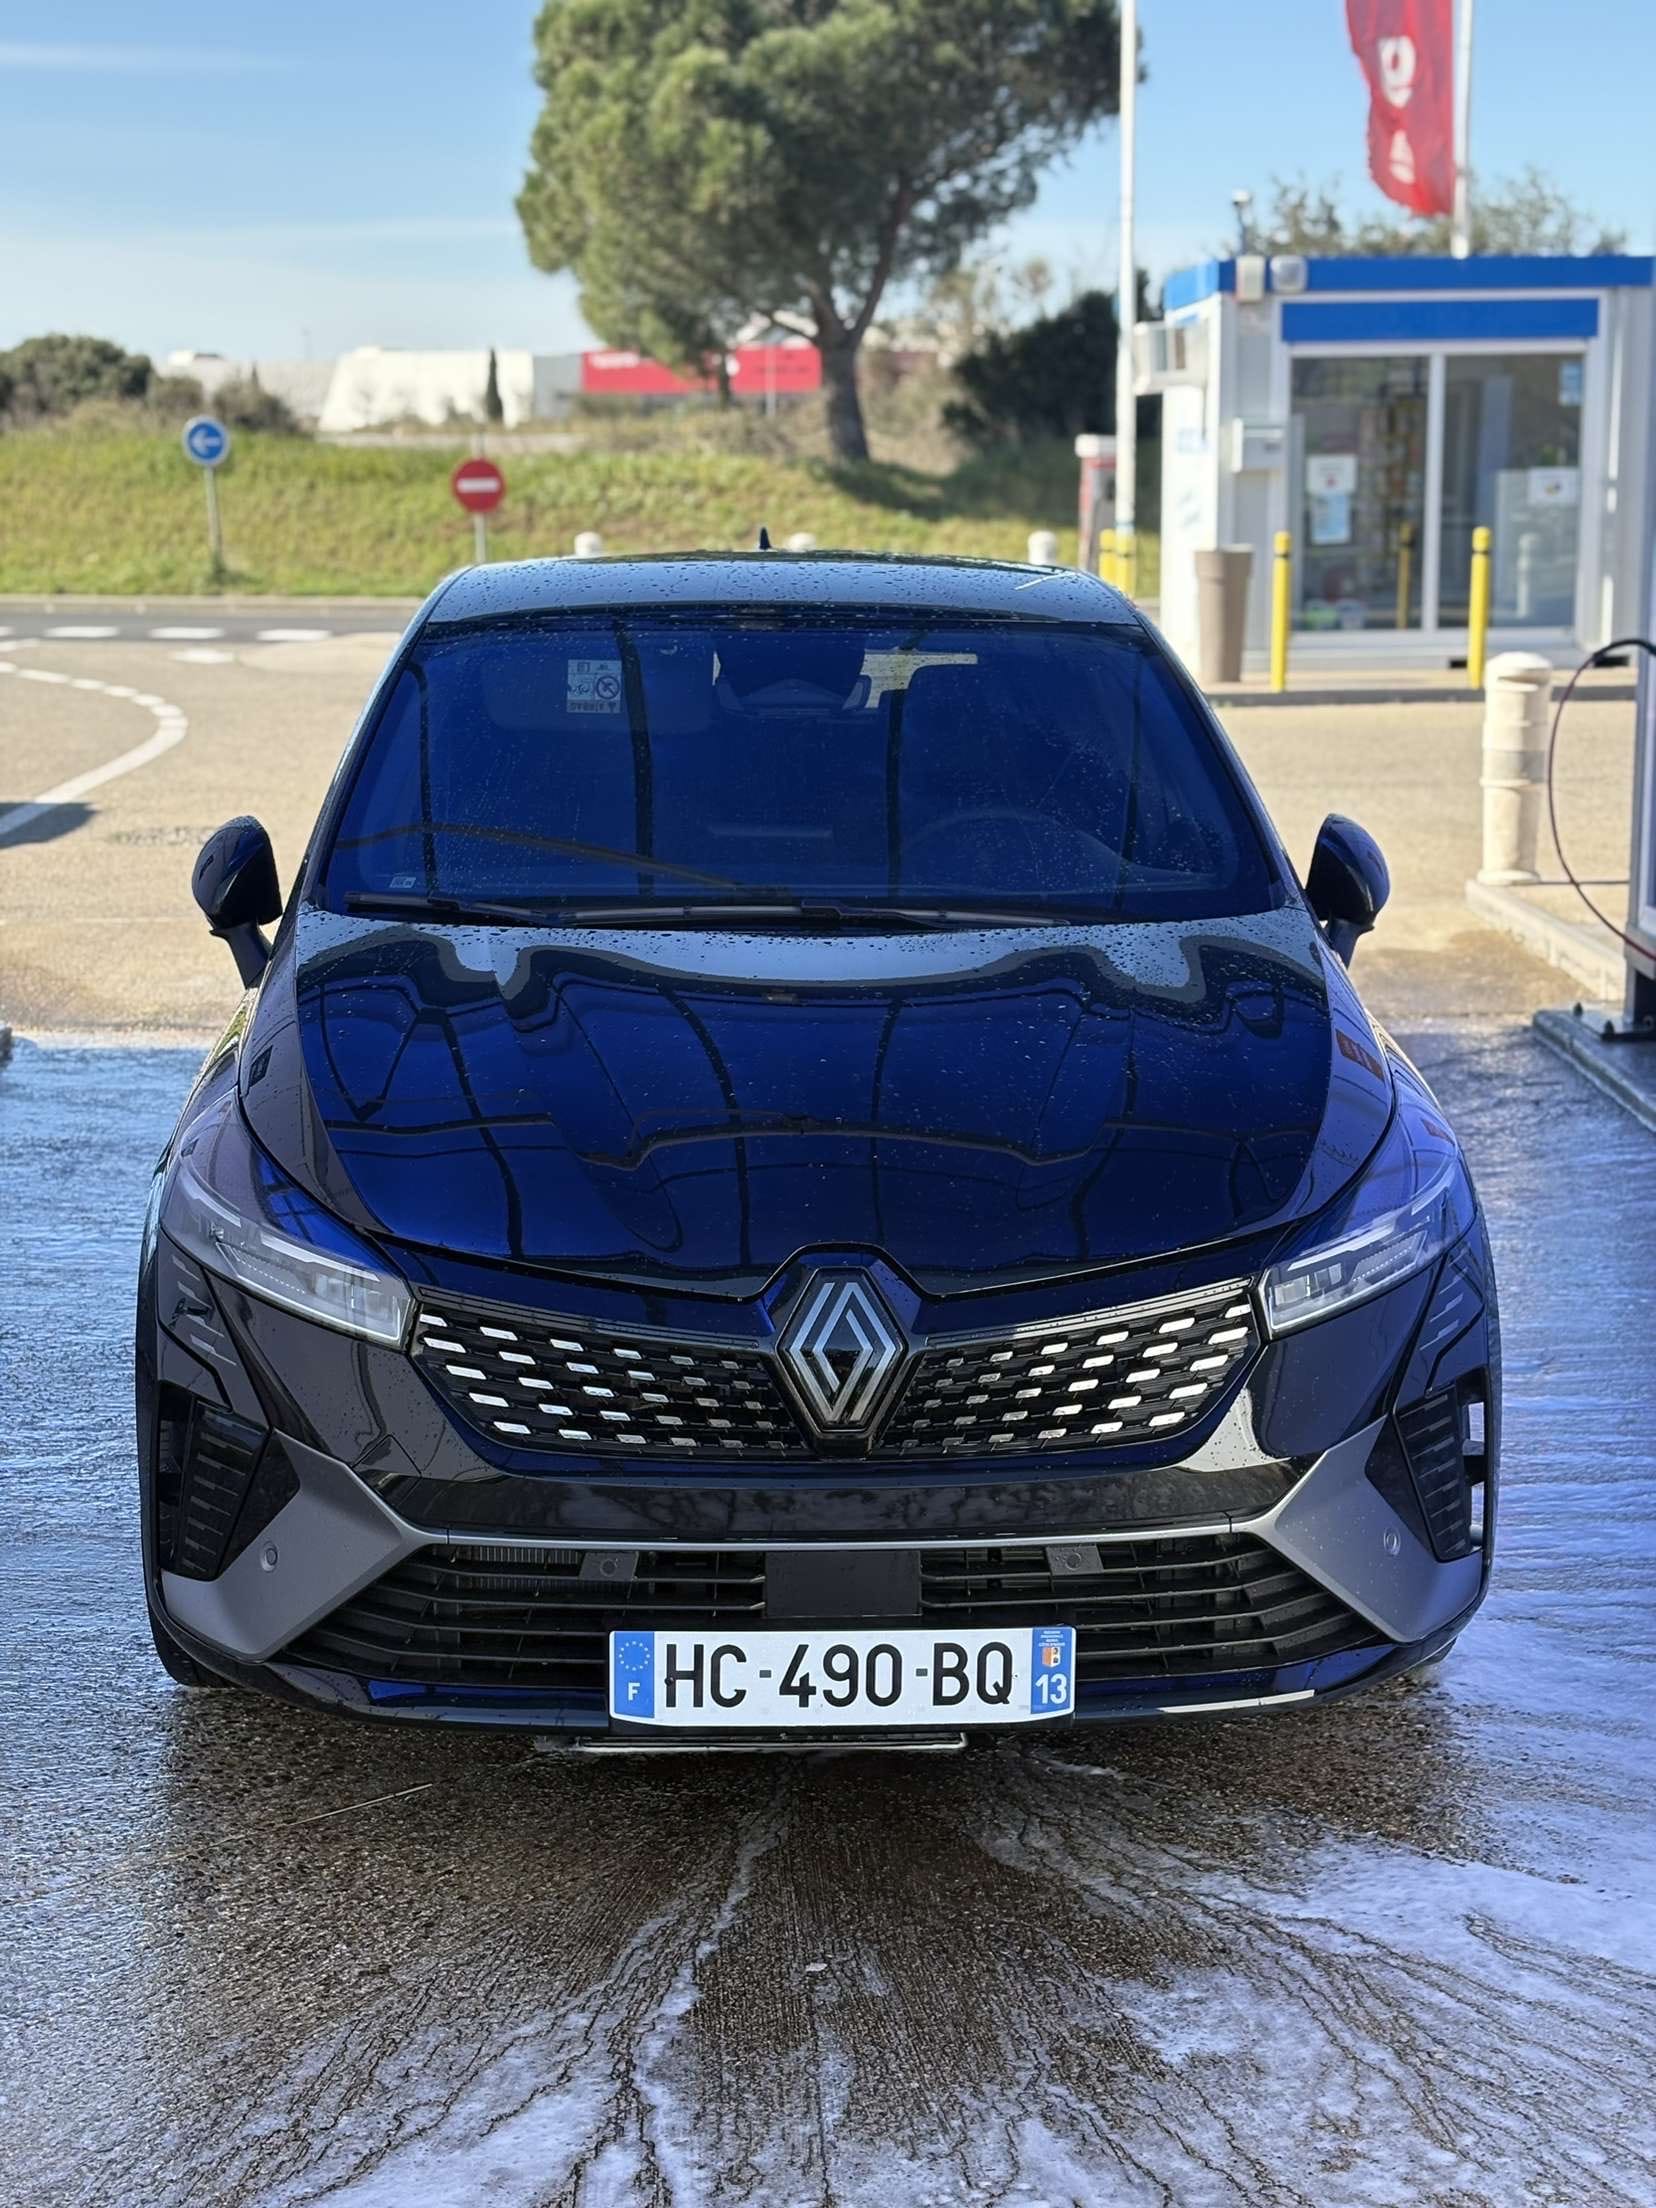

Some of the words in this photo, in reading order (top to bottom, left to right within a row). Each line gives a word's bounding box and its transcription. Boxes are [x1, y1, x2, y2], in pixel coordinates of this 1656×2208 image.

[665, 1642, 1013, 1708] HC-490-BQ
[1035, 1673, 1068, 1705] 13
[628, 1682, 641, 1701] F
